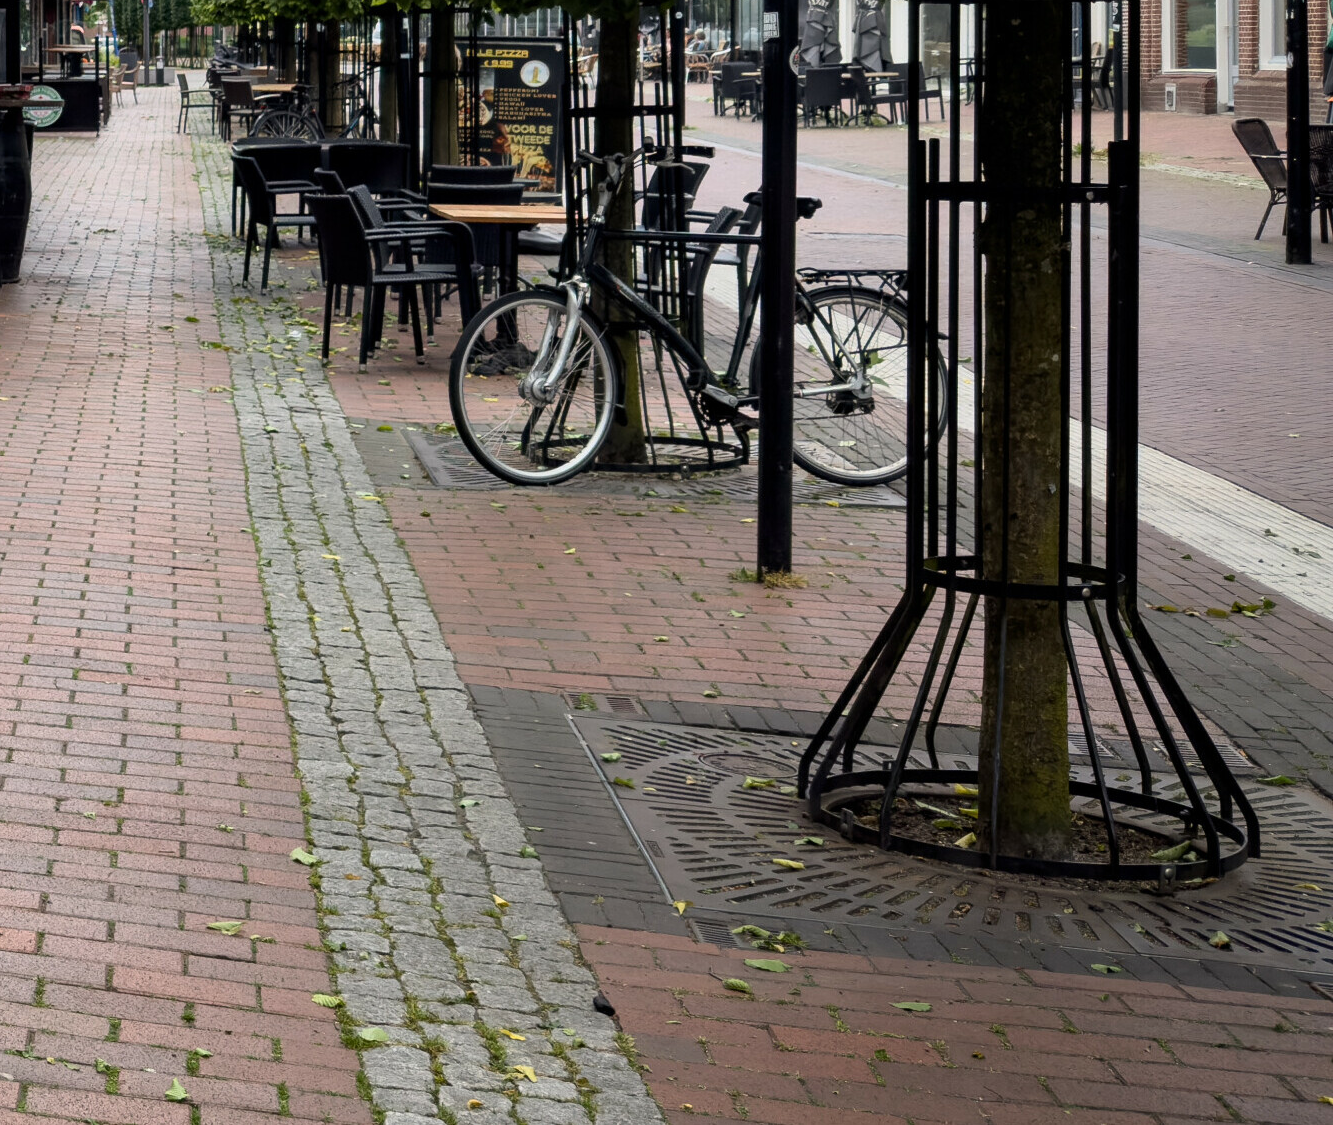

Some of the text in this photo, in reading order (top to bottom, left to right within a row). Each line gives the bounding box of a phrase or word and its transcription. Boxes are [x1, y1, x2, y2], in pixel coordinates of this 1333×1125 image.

[505, 124, 553, 135] VOOR DE
[508, 135, 550, 144] TWEEDE
